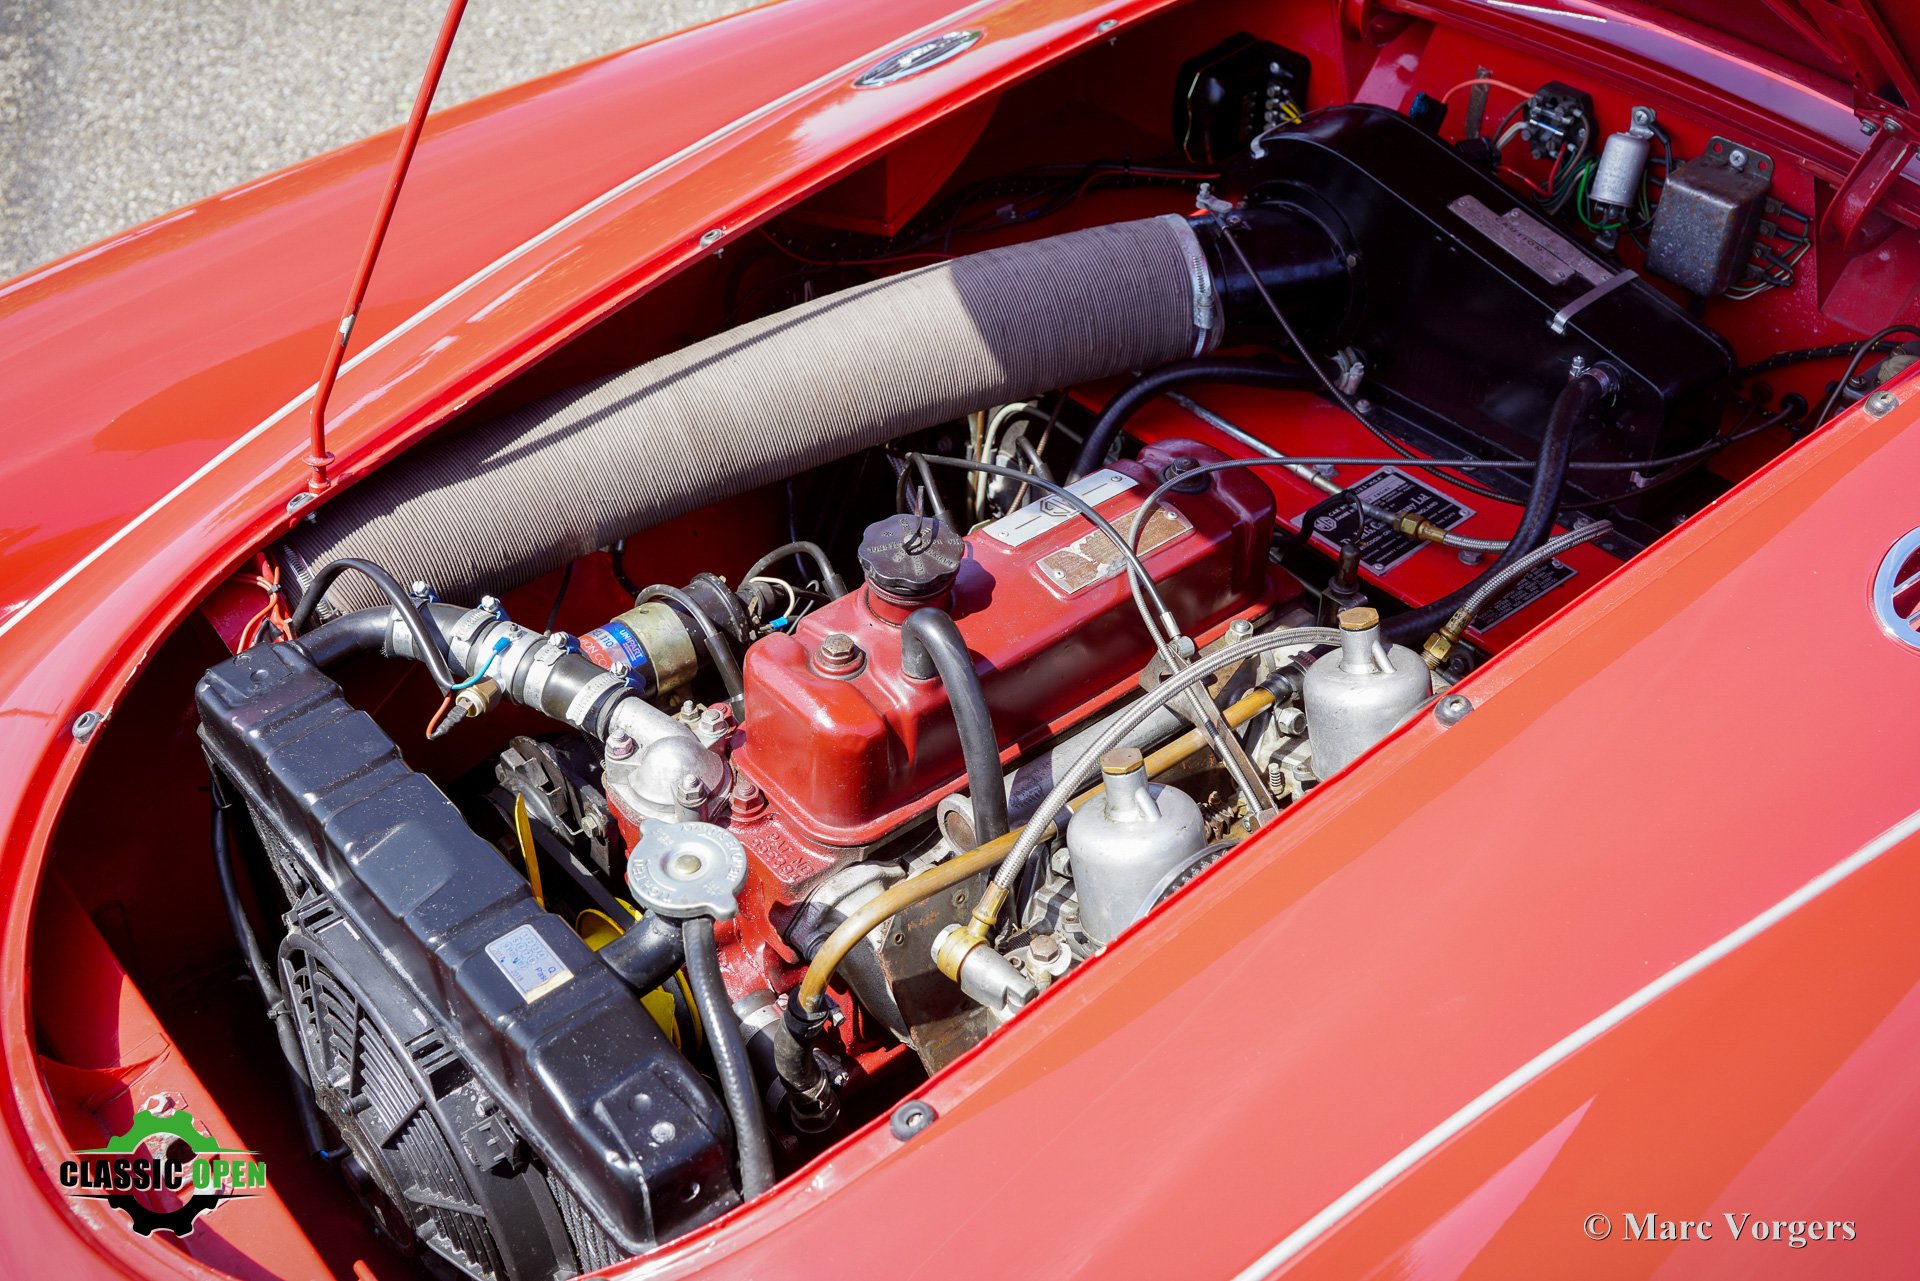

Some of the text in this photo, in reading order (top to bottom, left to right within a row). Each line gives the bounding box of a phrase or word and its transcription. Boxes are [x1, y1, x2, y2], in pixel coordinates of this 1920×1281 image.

[1495, 216, 1544, 252] CAUTION
[1314, 516, 1337, 531] MG
[601, 635, 614, 647] 110
[620, 629, 643, 658] UNIPART
